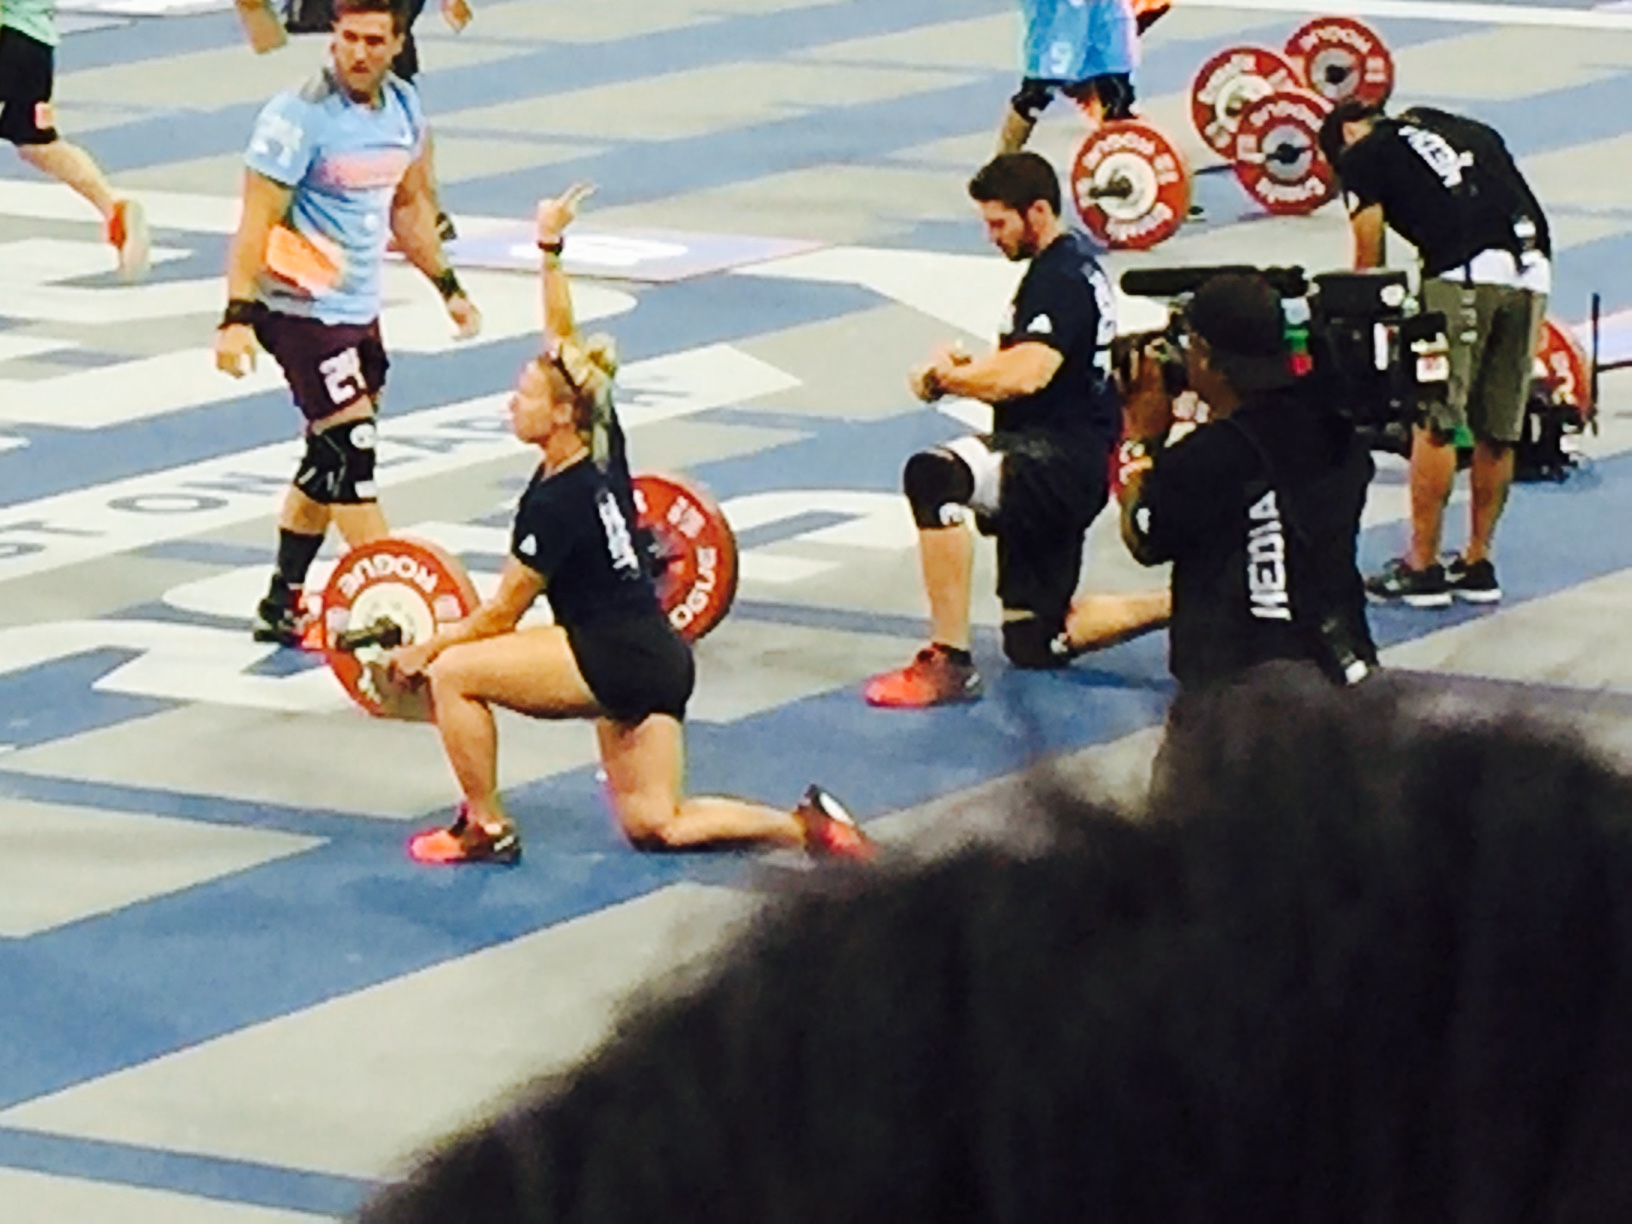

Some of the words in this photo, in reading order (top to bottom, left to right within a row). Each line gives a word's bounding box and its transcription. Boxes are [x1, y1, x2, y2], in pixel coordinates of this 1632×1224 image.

[337, 553, 440, 601] ROGUE
[668, 545, 718, 632] OGUE
[1248, 490, 1293, 622] MEDIA
